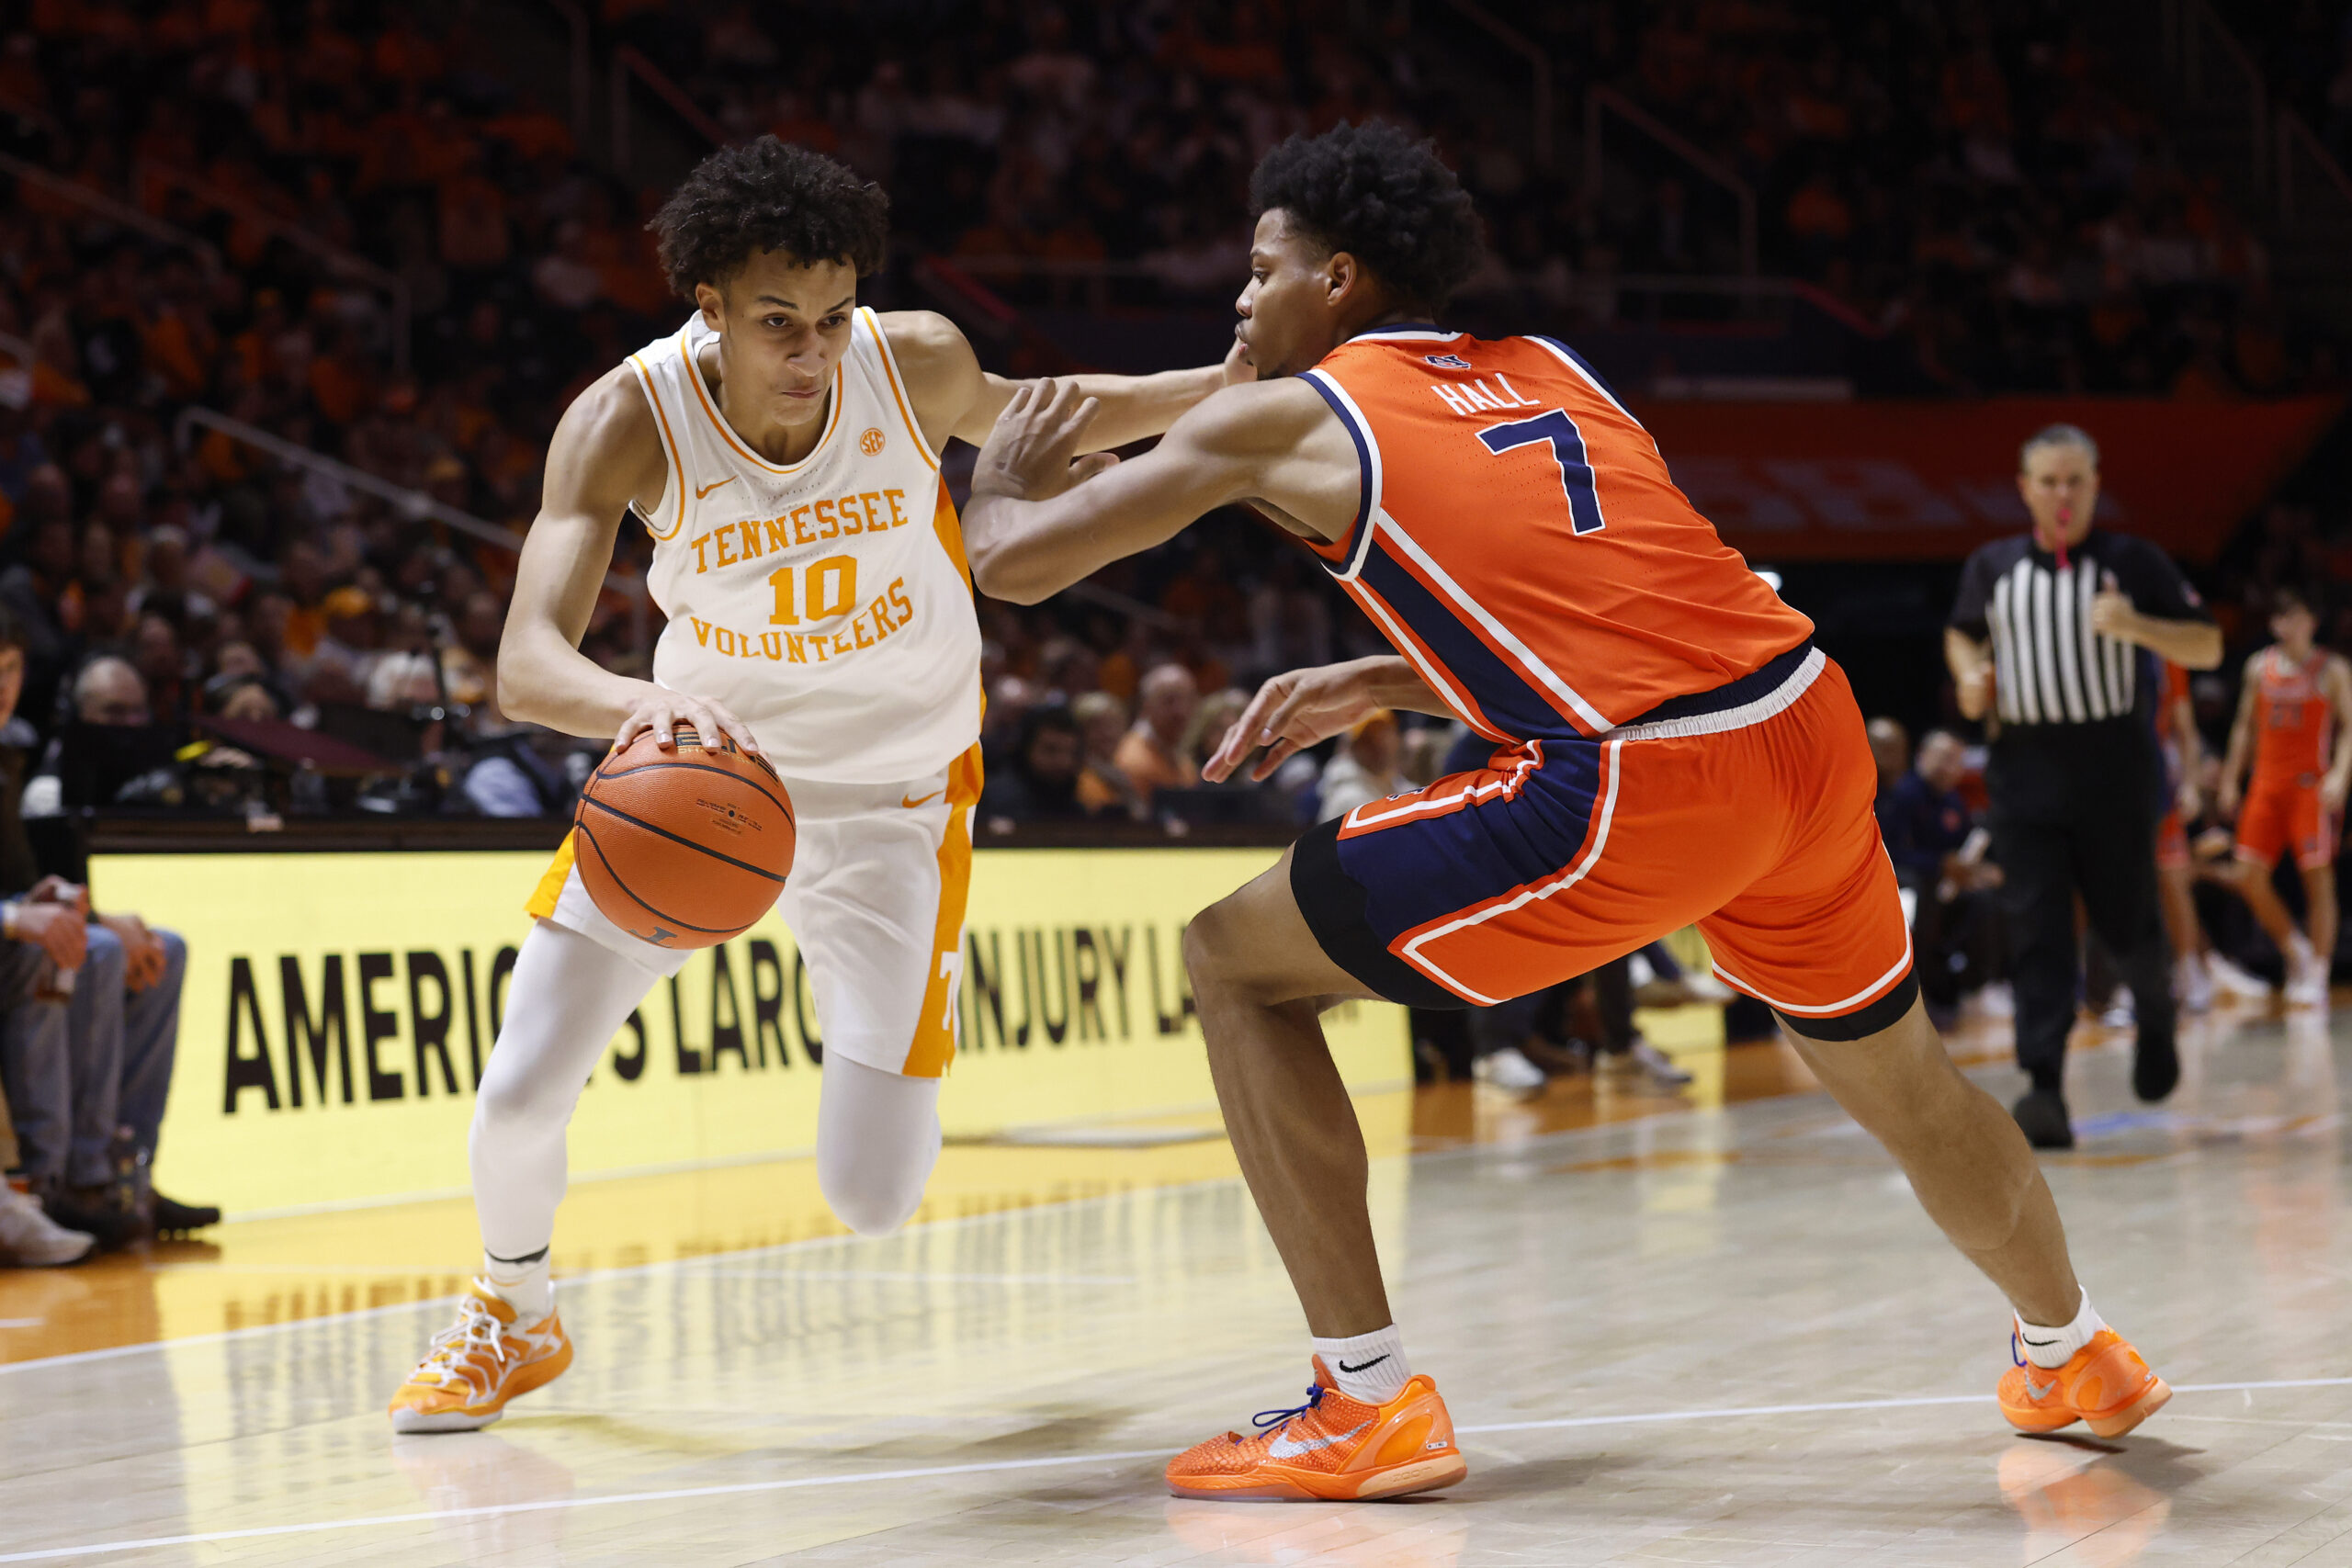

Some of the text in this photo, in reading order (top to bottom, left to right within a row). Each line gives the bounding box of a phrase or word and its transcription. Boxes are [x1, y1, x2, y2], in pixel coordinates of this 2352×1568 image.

[1430, 372, 1541, 415] HALL
[862, 430, 884, 455] SEC
[1475, 408, 1605, 536] 7
[691, 489, 908, 574] TENNESSEE
[690, 576, 912, 663] VOLUNTEERS
[768, 555, 857, 626] 10
